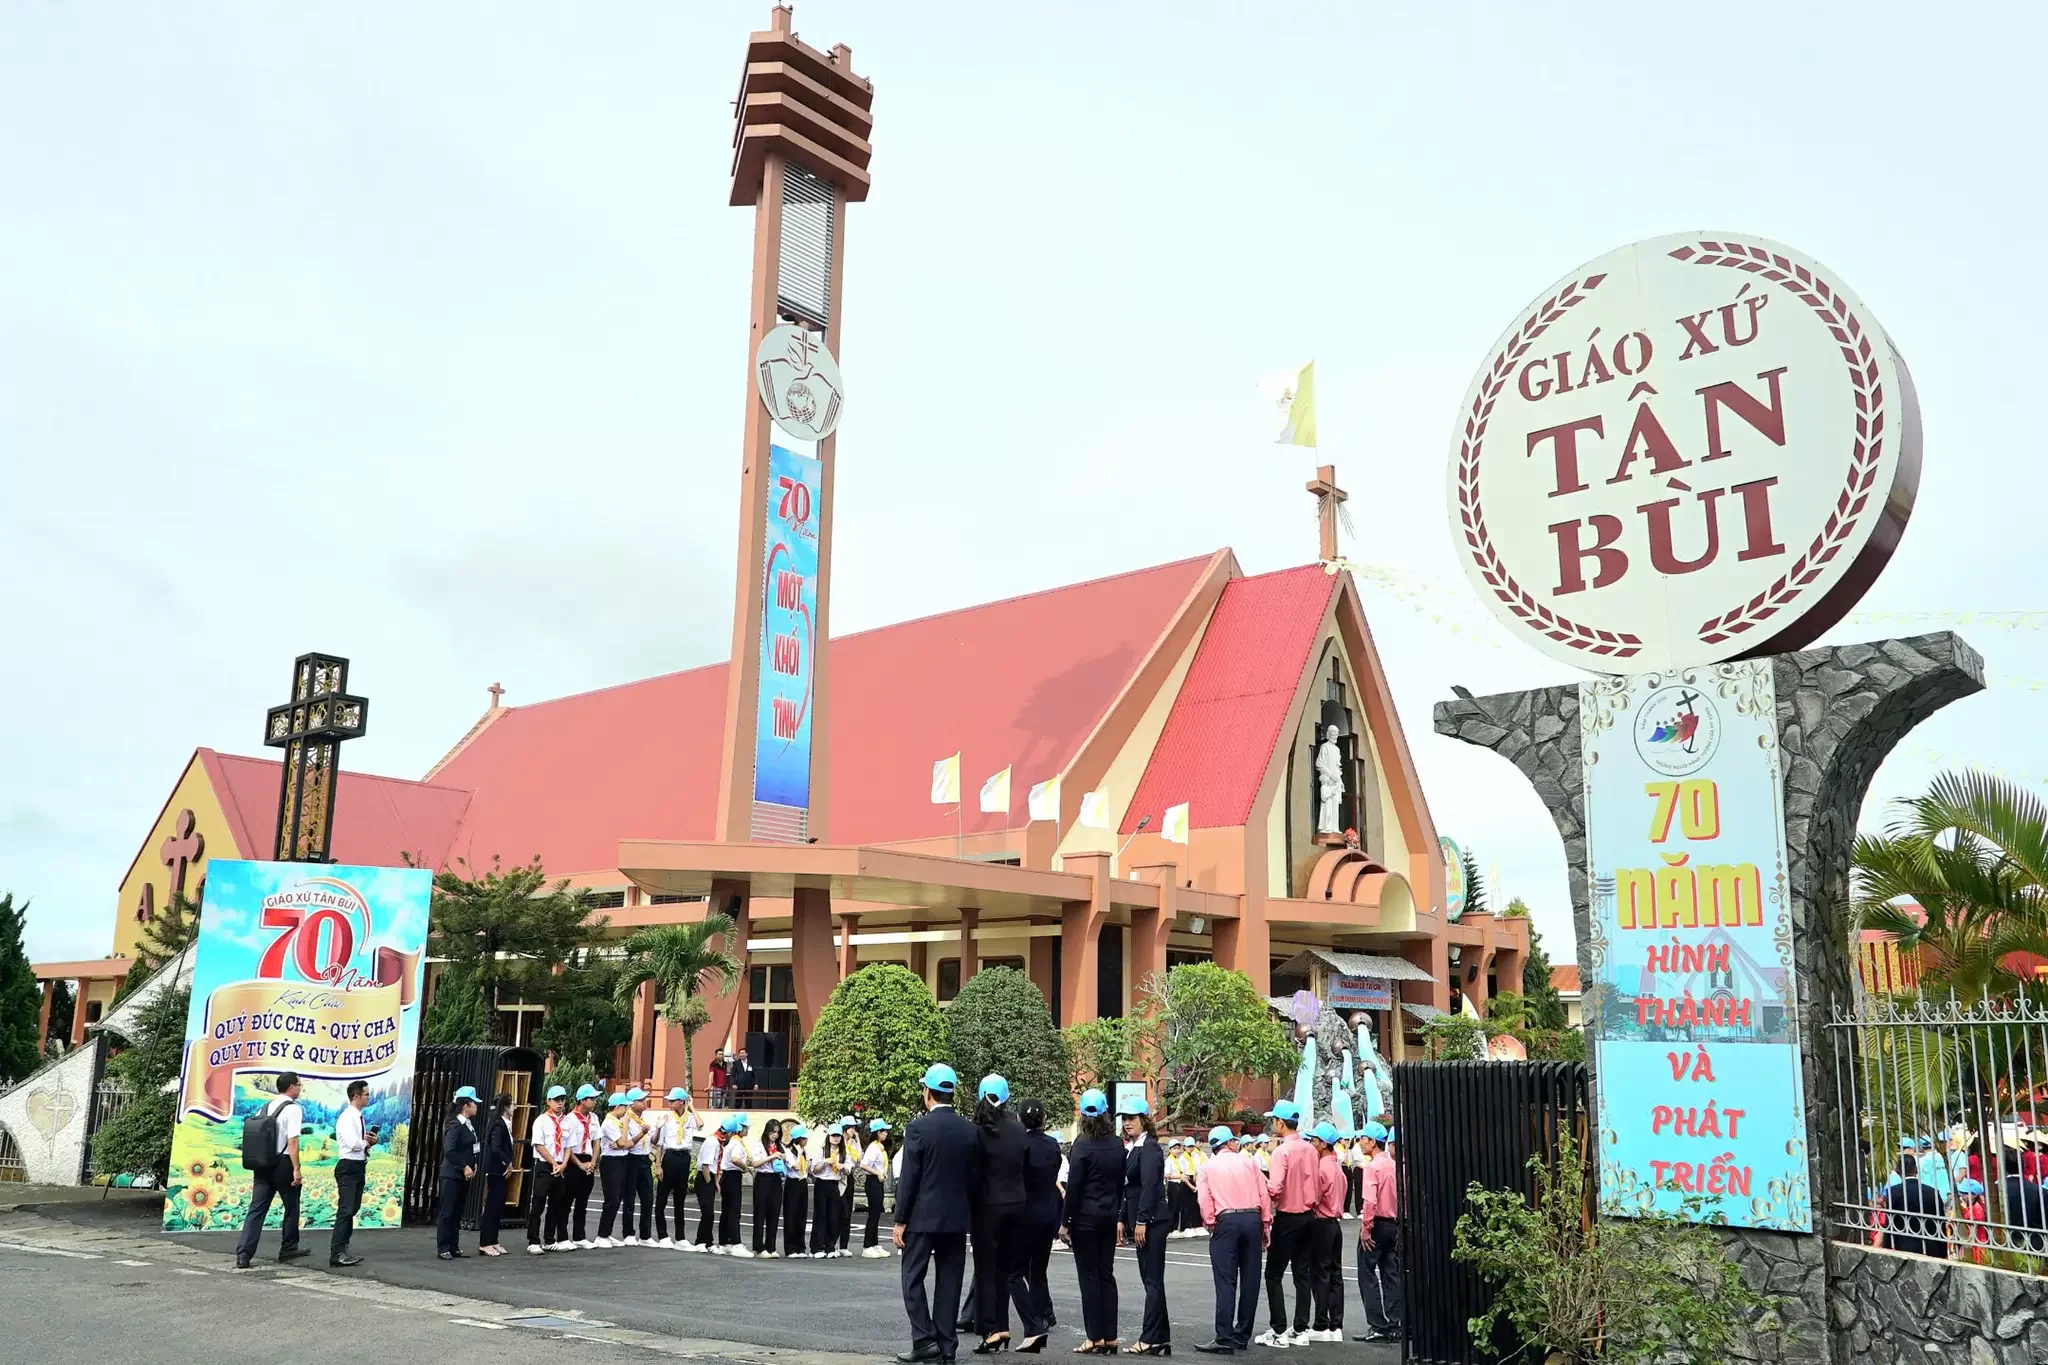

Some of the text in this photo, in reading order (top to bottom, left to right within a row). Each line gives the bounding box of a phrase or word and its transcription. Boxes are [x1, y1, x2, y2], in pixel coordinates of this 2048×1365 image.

[1518, 283, 1769, 402] GIÁO XỨ
[1526, 366, 1788, 498] TÂN
[779, 476, 810, 522] 70
[1548, 476, 1786, 597] BÙI
[777, 566, 803, 619] MỘT
[774, 625, 800, 676] KHỐI
[1644, 778, 1720, 843] 70
[266, 891, 356, 911] GIÁO XỨ TÂN BÙI
[259, 908, 353, 980] 70
[1647, 936, 1731, 973] HÌNH
[321, 964, 383, 992] Năm
[214, 1011, 247, 1039] QUÝ
[286, 1016, 316, 1034] CHA
[330, 1019, 361, 1040] QUÝ
[364, 1016, 396, 1038] CHA
[1633, 989, 1752, 1027] THÀNH
[210, 1039, 242, 1065] QUÝ
[247, 1042, 267, 1056] TU
[293, 1045, 305, 1060] &
[309, 1046, 339, 1064] QUÝ
[343, 1040, 395, 1065] KHÁCH
[1667, 1044, 1716, 1082] VÀ
[1652, 1099, 1746, 1139] PHÁT
[1649, 1152, 1752, 1197] TRIỂN
